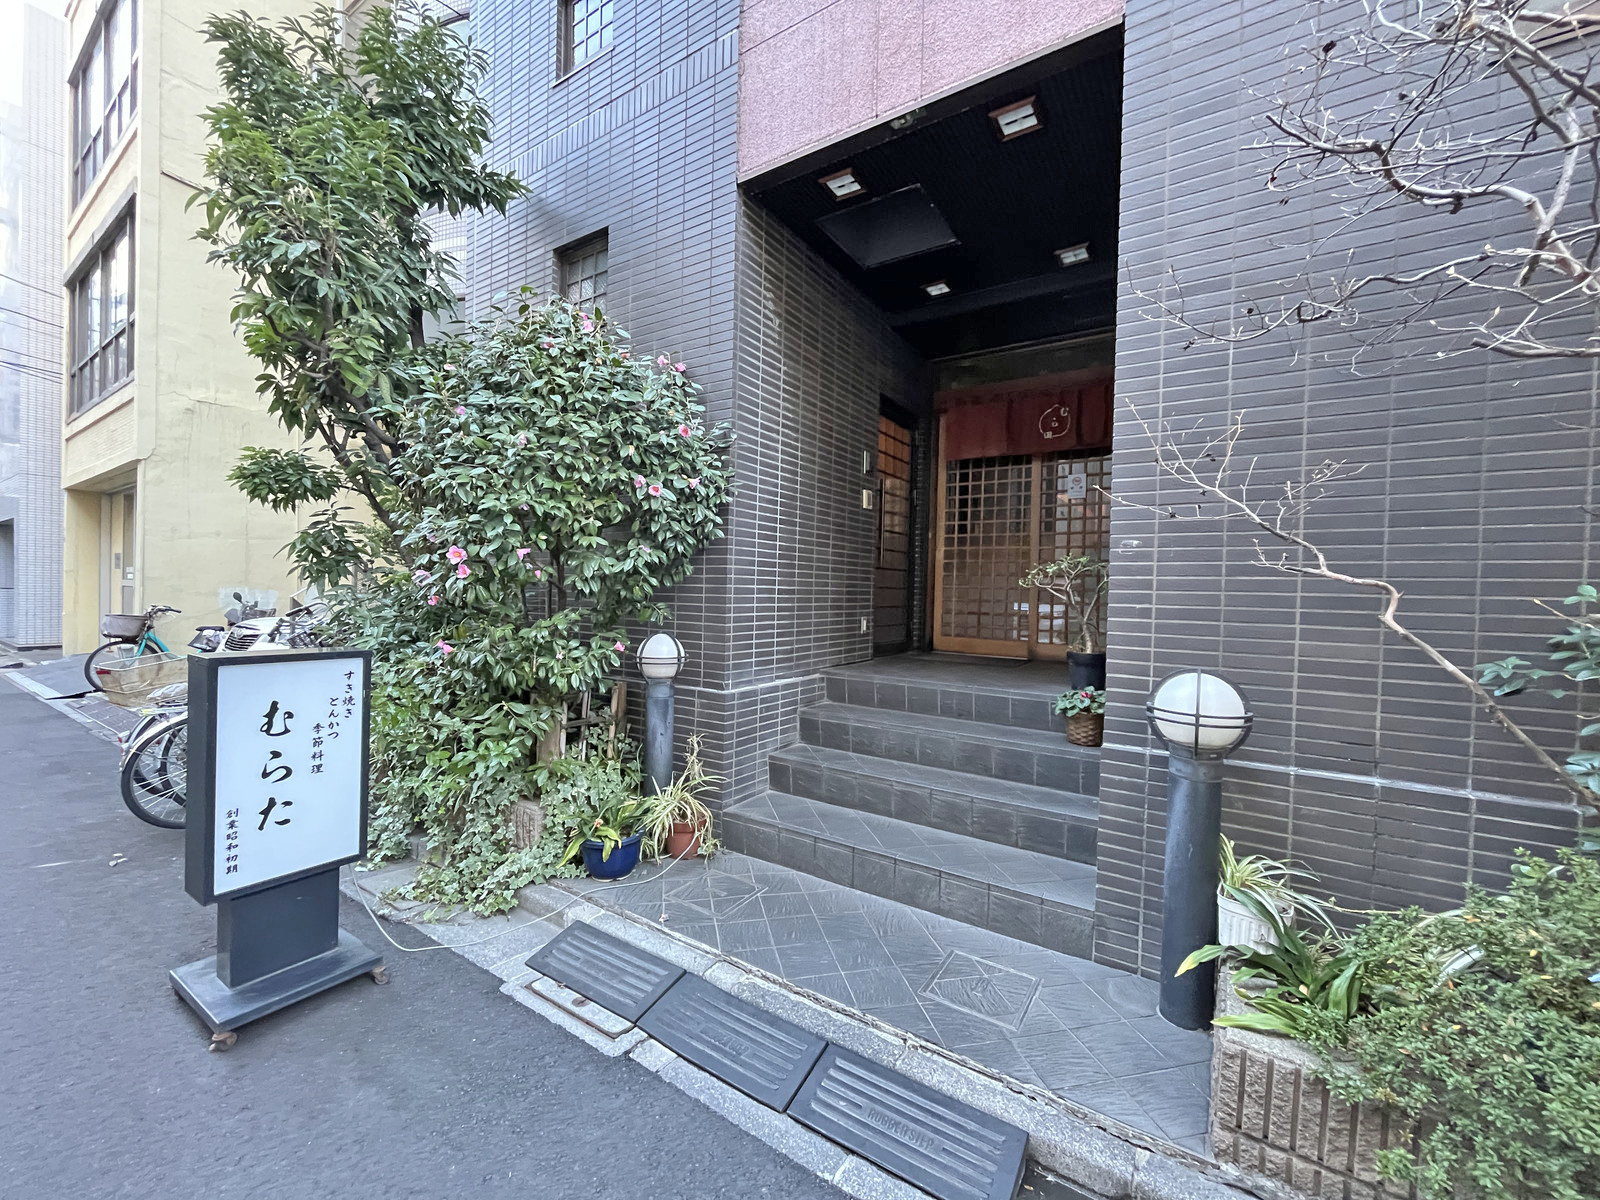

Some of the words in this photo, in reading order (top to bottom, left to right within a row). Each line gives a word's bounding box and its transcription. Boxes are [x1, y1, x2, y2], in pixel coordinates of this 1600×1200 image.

[327, 697, 340, 739] とんかつ
[342, 670, 356, 719] すき焼き
[257, 700, 295, 832] むらた
[310, 722, 325, 774] 季節料理
[225, 807, 239, 875] 創業昭和初期
